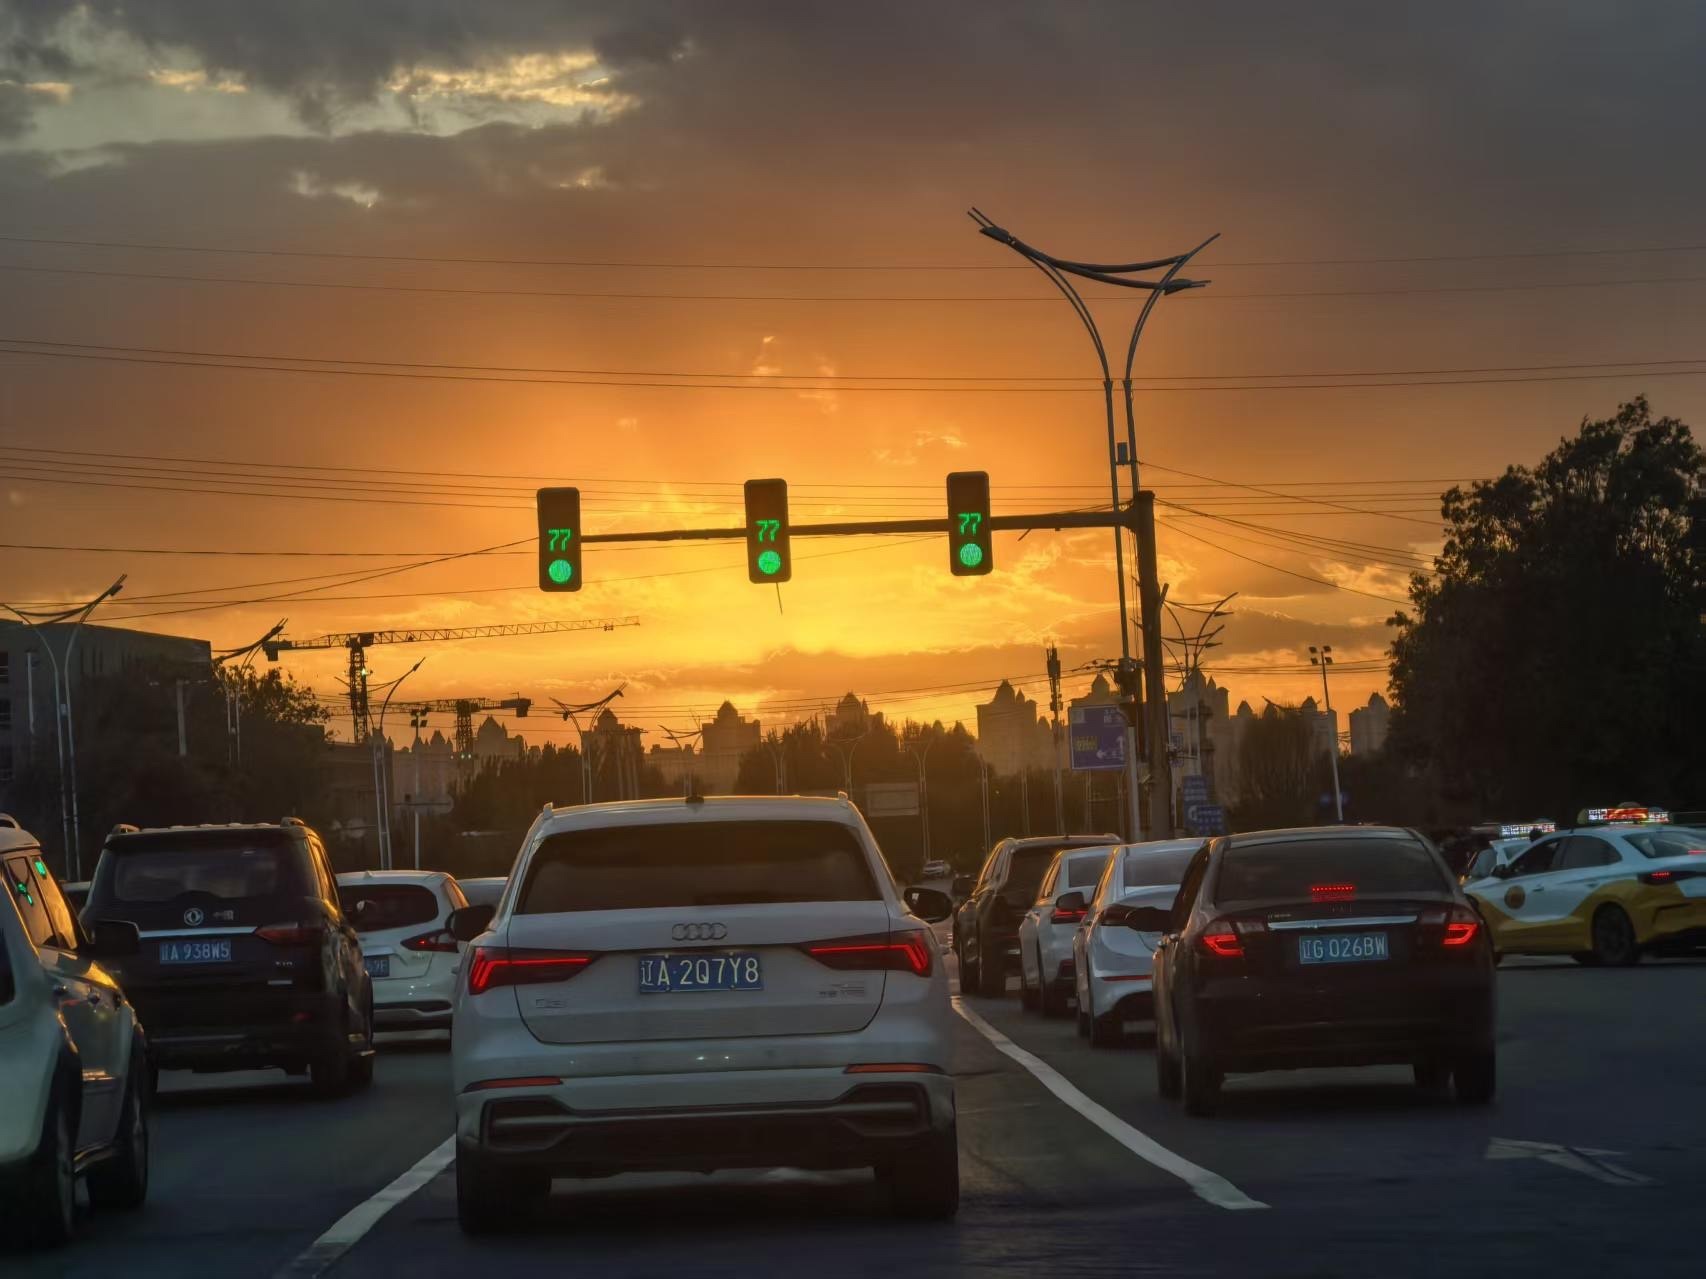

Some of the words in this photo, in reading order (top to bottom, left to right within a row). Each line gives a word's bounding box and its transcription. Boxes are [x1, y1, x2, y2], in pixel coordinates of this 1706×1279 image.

[756, 519, 780, 542] 77
[958, 512, 982, 535] 77
[548, 528, 571, 552] 77
